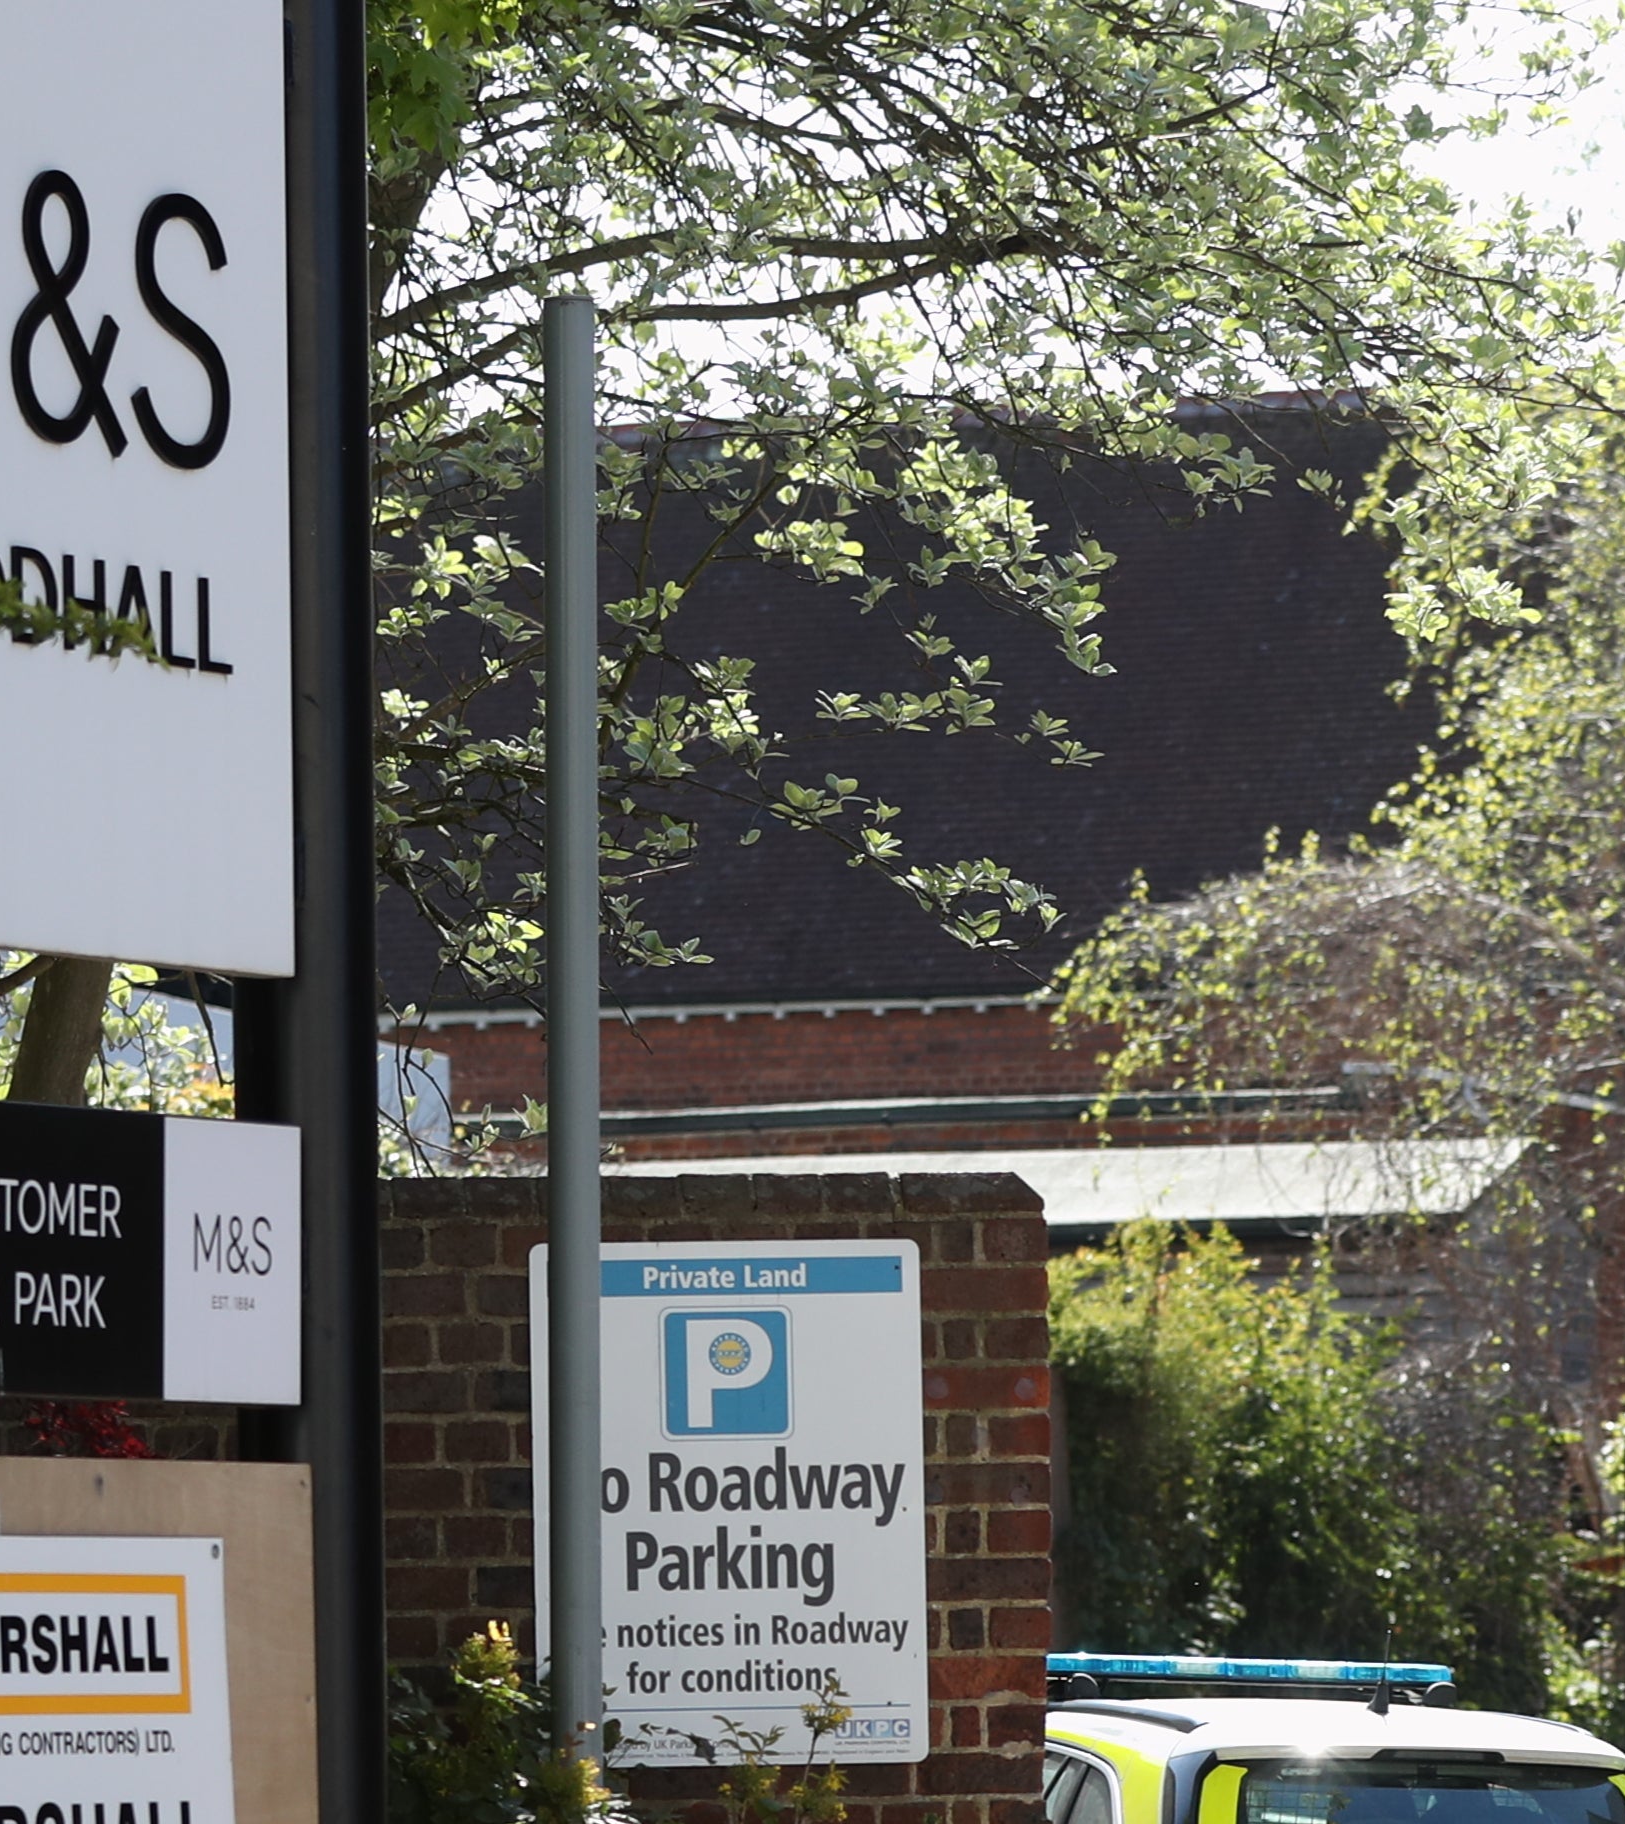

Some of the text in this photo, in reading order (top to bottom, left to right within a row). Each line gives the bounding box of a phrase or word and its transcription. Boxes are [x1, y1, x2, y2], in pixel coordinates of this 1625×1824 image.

[192, 1211, 274, 1277] M&S
[14, 1271, 107, 1329] PARK
[642, 1263, 808, 1289] Private Land
[601, 1446, 906, 1527] o Roadway
[625, 1525, 835, 1607] Parking
[616, 1614, 724, 1648] notices
[734, 1613, 761, 1646] in
[771, 1611, 910, 1652] Roadway
[626, 1658, 837, 1695] for conditions
[19, 1727, 140, 1757] CONTRACTORS)
[145, 1729, 175, 1753] LTD.
